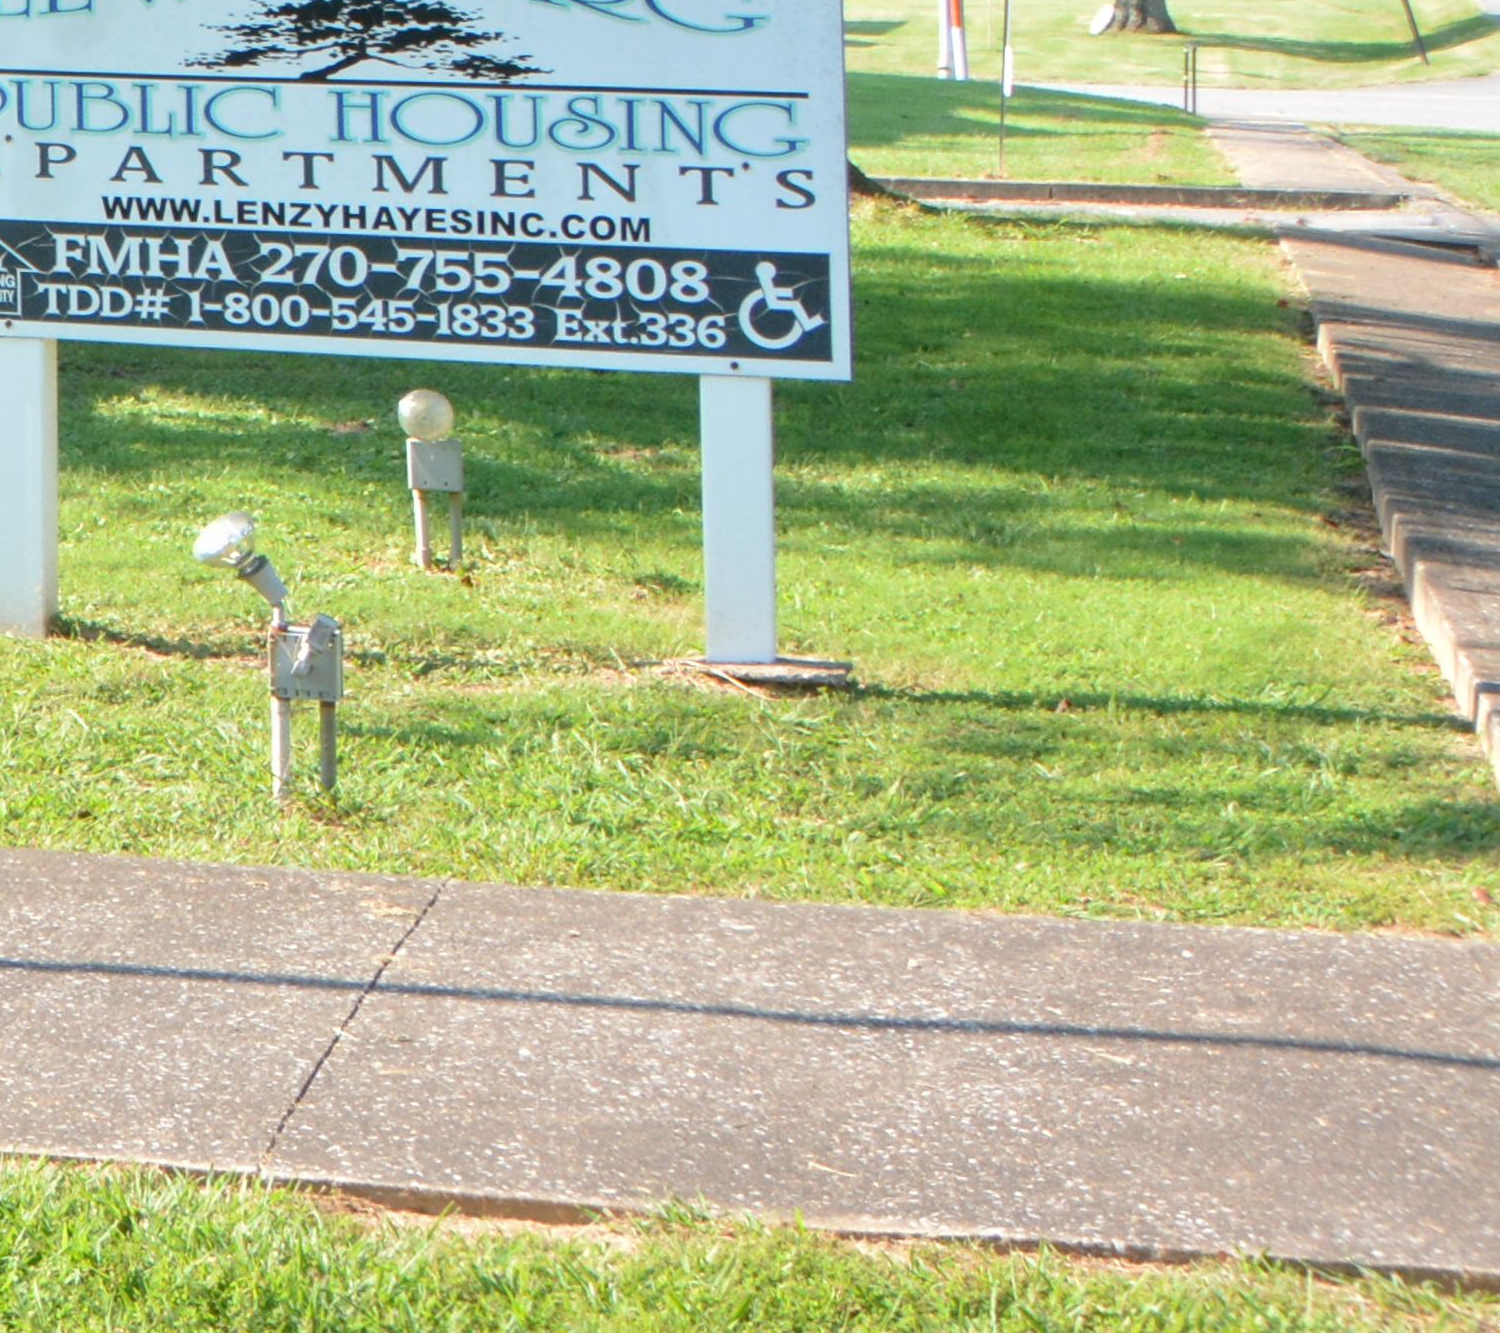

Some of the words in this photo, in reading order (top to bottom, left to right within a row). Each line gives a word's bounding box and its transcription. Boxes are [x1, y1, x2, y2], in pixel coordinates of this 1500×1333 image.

[327, 90, 810, 159] HOUSING
[101, 195, 652, 243] WWW.LENZYHAYESINC.COM
[50, 234, 238, 281] FMHA
[258, 241, 710, 304] 270-755-4808
[37, 282, 171, 320] TDD#
[188, 289, 535, 340] 1-800-545-1833
[554, 308, 727, 349] Ext.336
